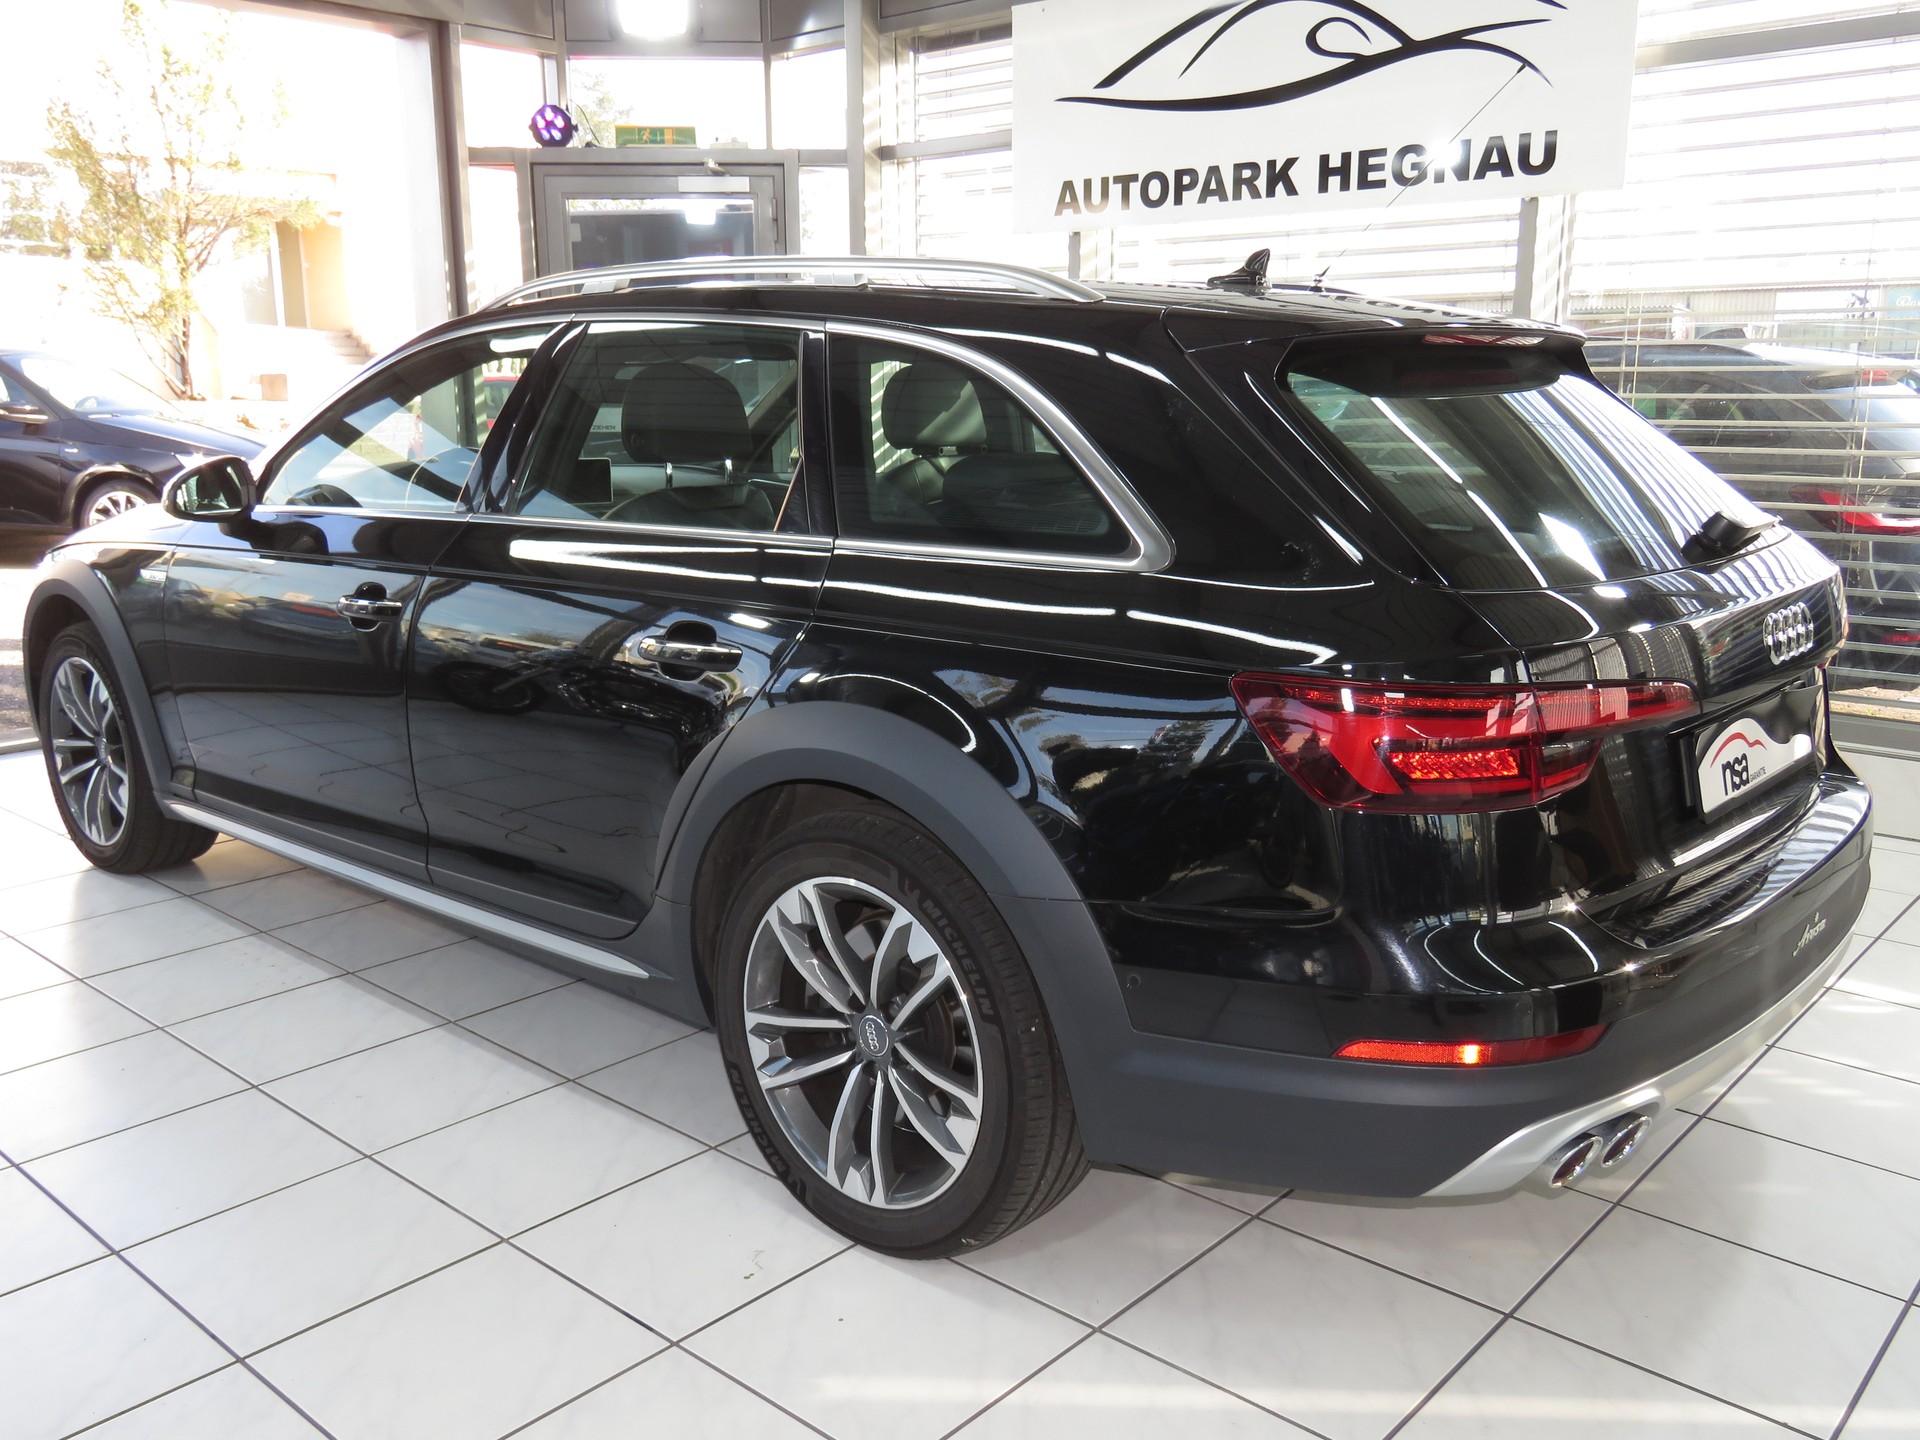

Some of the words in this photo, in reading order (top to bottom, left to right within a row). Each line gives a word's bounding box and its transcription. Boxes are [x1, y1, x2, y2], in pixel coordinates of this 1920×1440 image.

[1054, 157, 1300, 216] AUTOPARK
[1318, 130, 1558, 193] HEGNAU
[1721, 753, 1750, 796] nsa
[922, 899, 994, 1017] MICHELIN
[728, 1067, 787, 1173] MICHELIN
